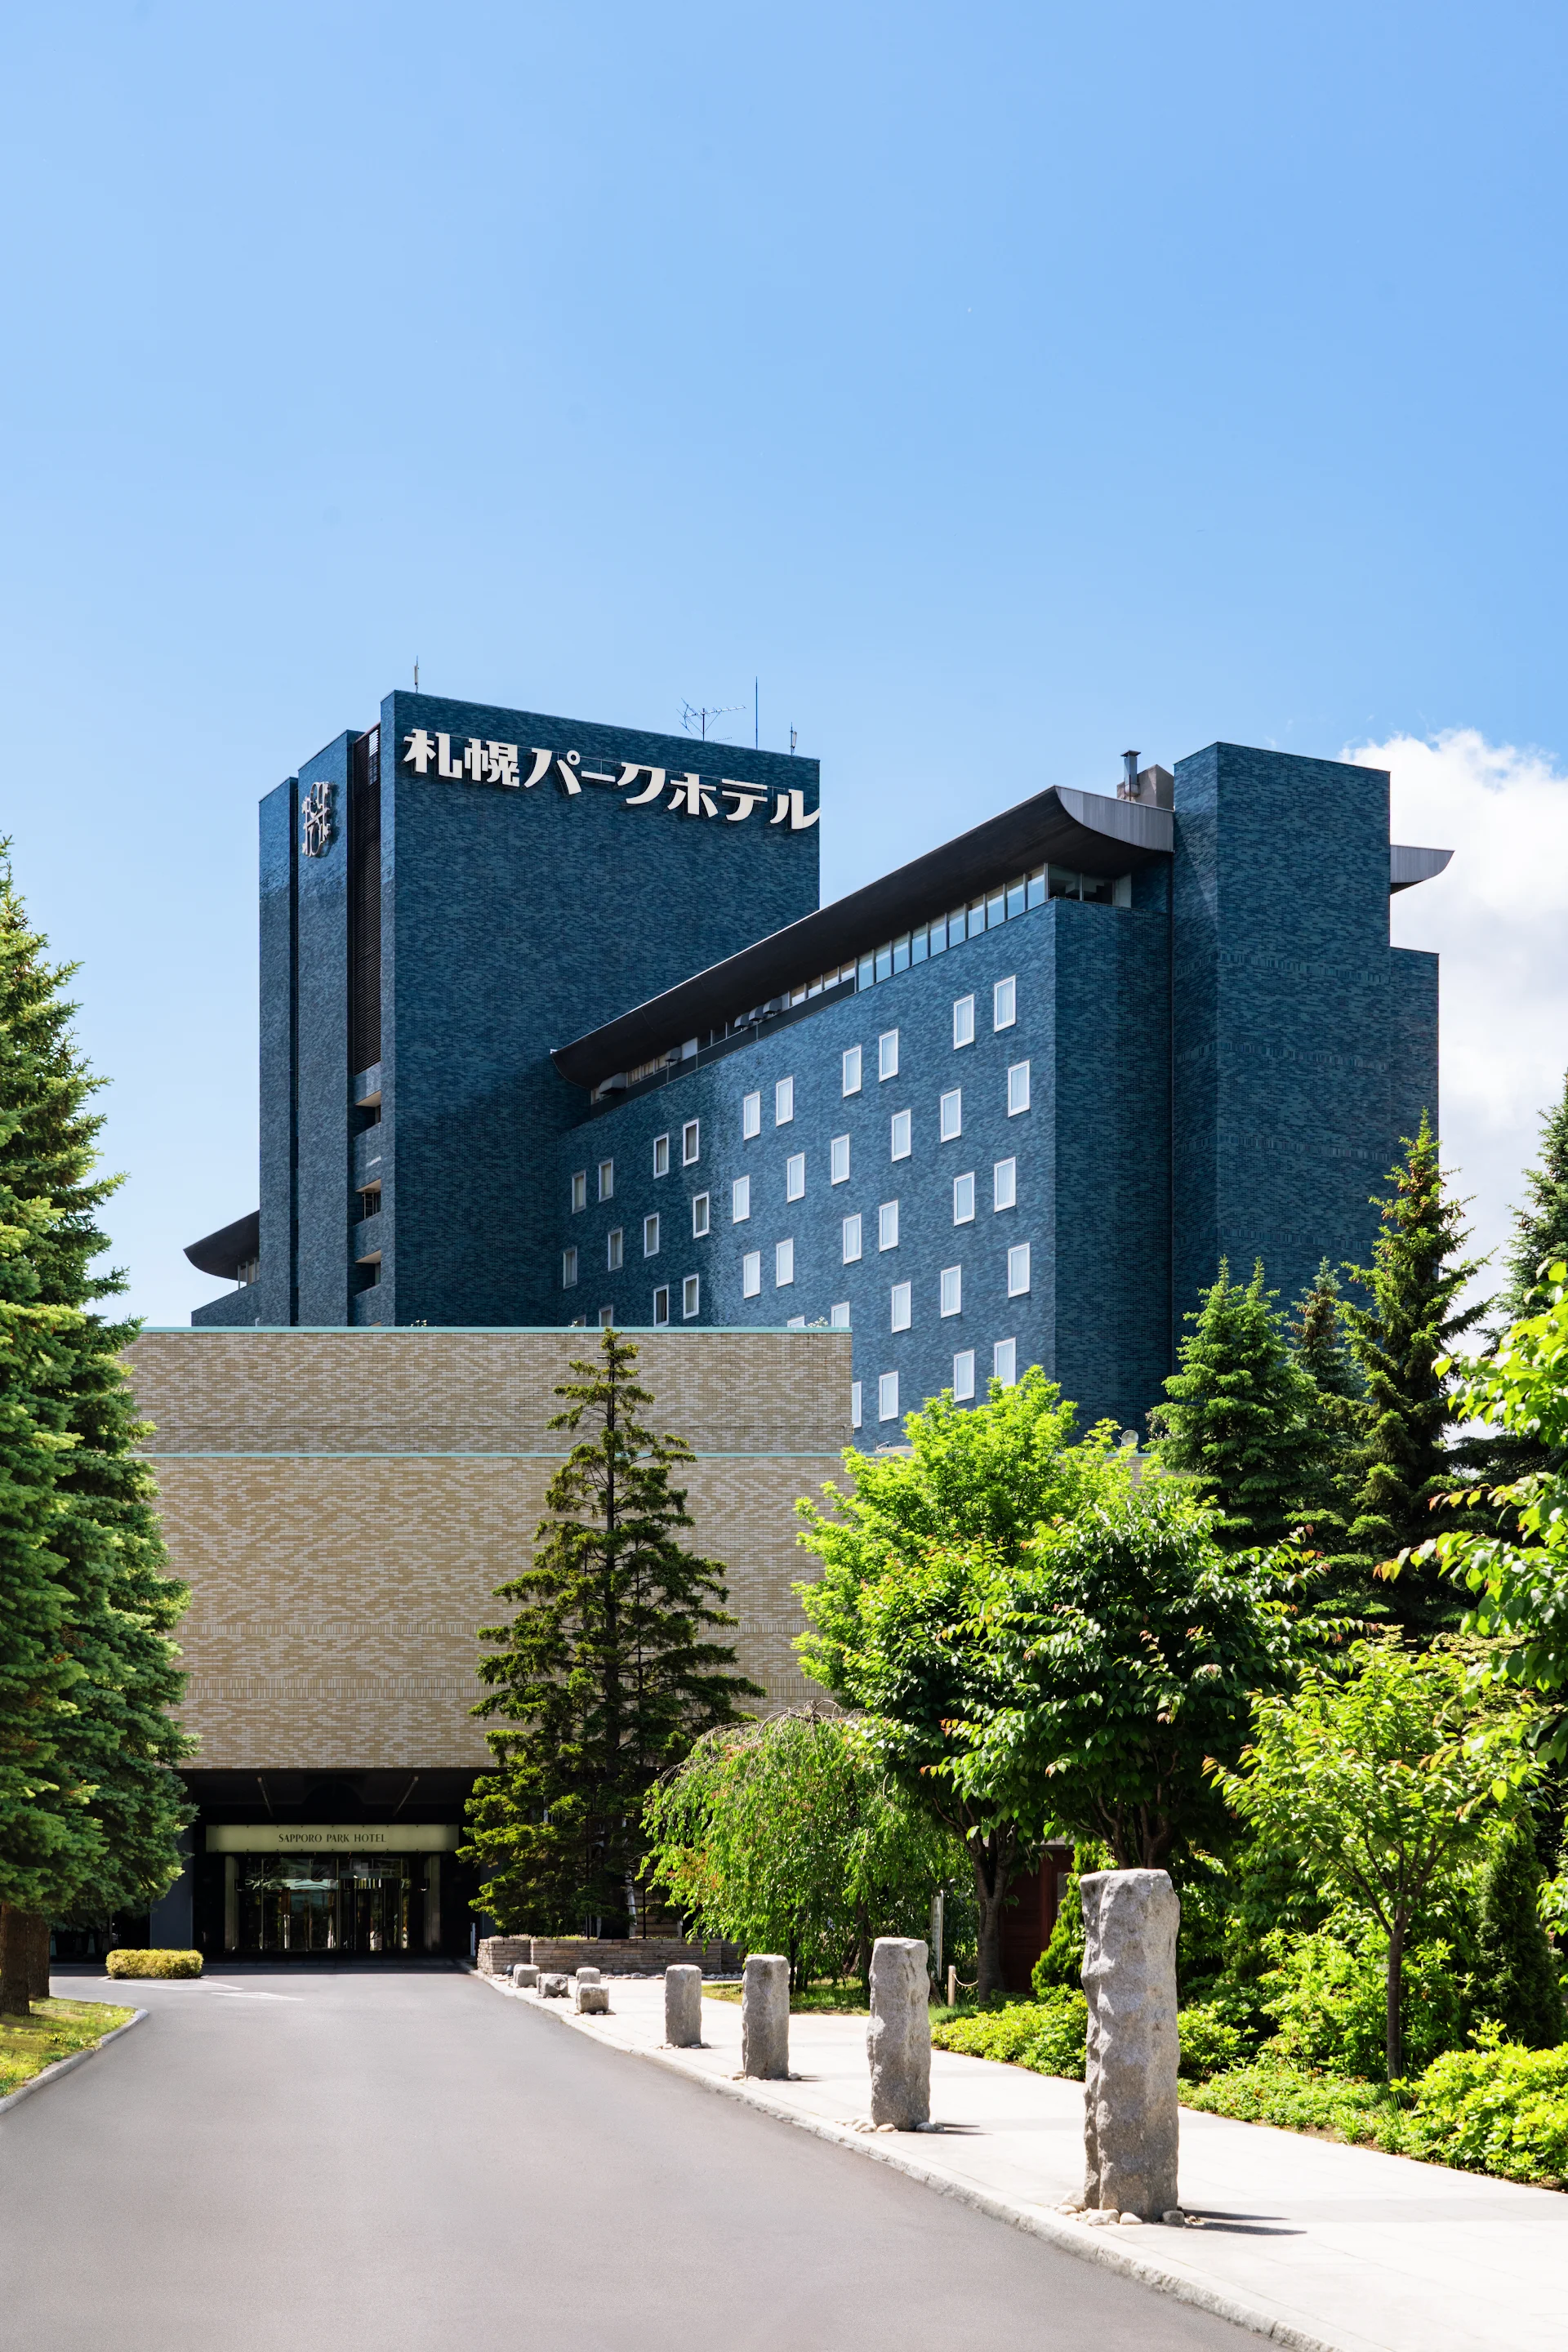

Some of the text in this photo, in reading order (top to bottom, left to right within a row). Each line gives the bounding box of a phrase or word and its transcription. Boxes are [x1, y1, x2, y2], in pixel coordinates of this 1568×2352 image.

[403, 728, 820, 830] 札幌パークホテル
[278, 1833, 386, 1843] SAPPORO PARK HOTEL
